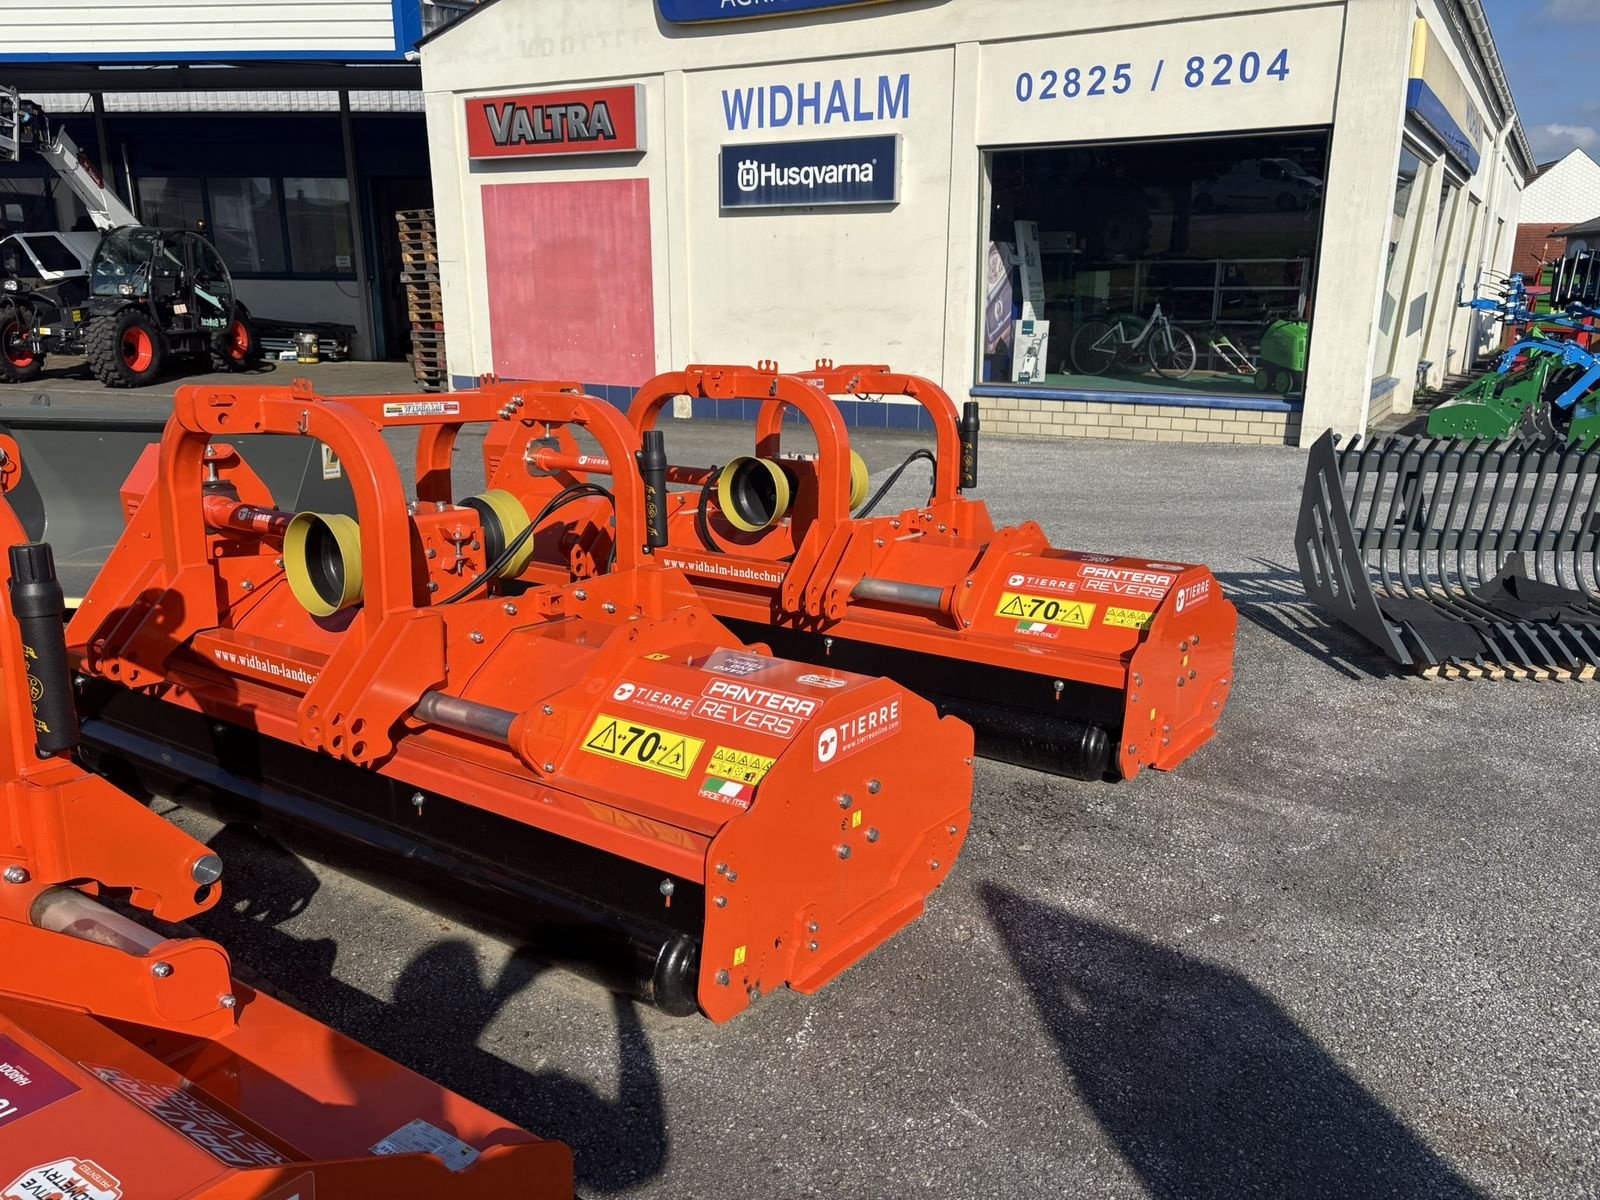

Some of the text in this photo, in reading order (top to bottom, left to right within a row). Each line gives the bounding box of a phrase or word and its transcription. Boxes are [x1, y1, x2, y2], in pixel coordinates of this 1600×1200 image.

[1015, 48, 1288, 101] 02825 / 8204
[721, 73, 910, 131] WIDHALM
[484, 101, 617, 146] VALTRA
[760, 162, 874, 188] Husqvarna
[1026, 576, 1077, 590] TIERRE
[1082, 567, 1171, 585] PANTERA
[1085, 579, 1166, 599] REVERS
[1185, 579, 1209, 601] TIERRE
[1029, 598, 1060, 621] 70
[214, 647, 321, 685] www.widhalm-landtec
[636, 687, 694, 710] TIERRE
[708, 681, 817, 716] PANTERA
[697, 700, 796, 735] REVERS
[839, 700, 899, 742] TIERRE
[619, 727, 662, 763] 70
[698, 790, 721, 801] MADE
